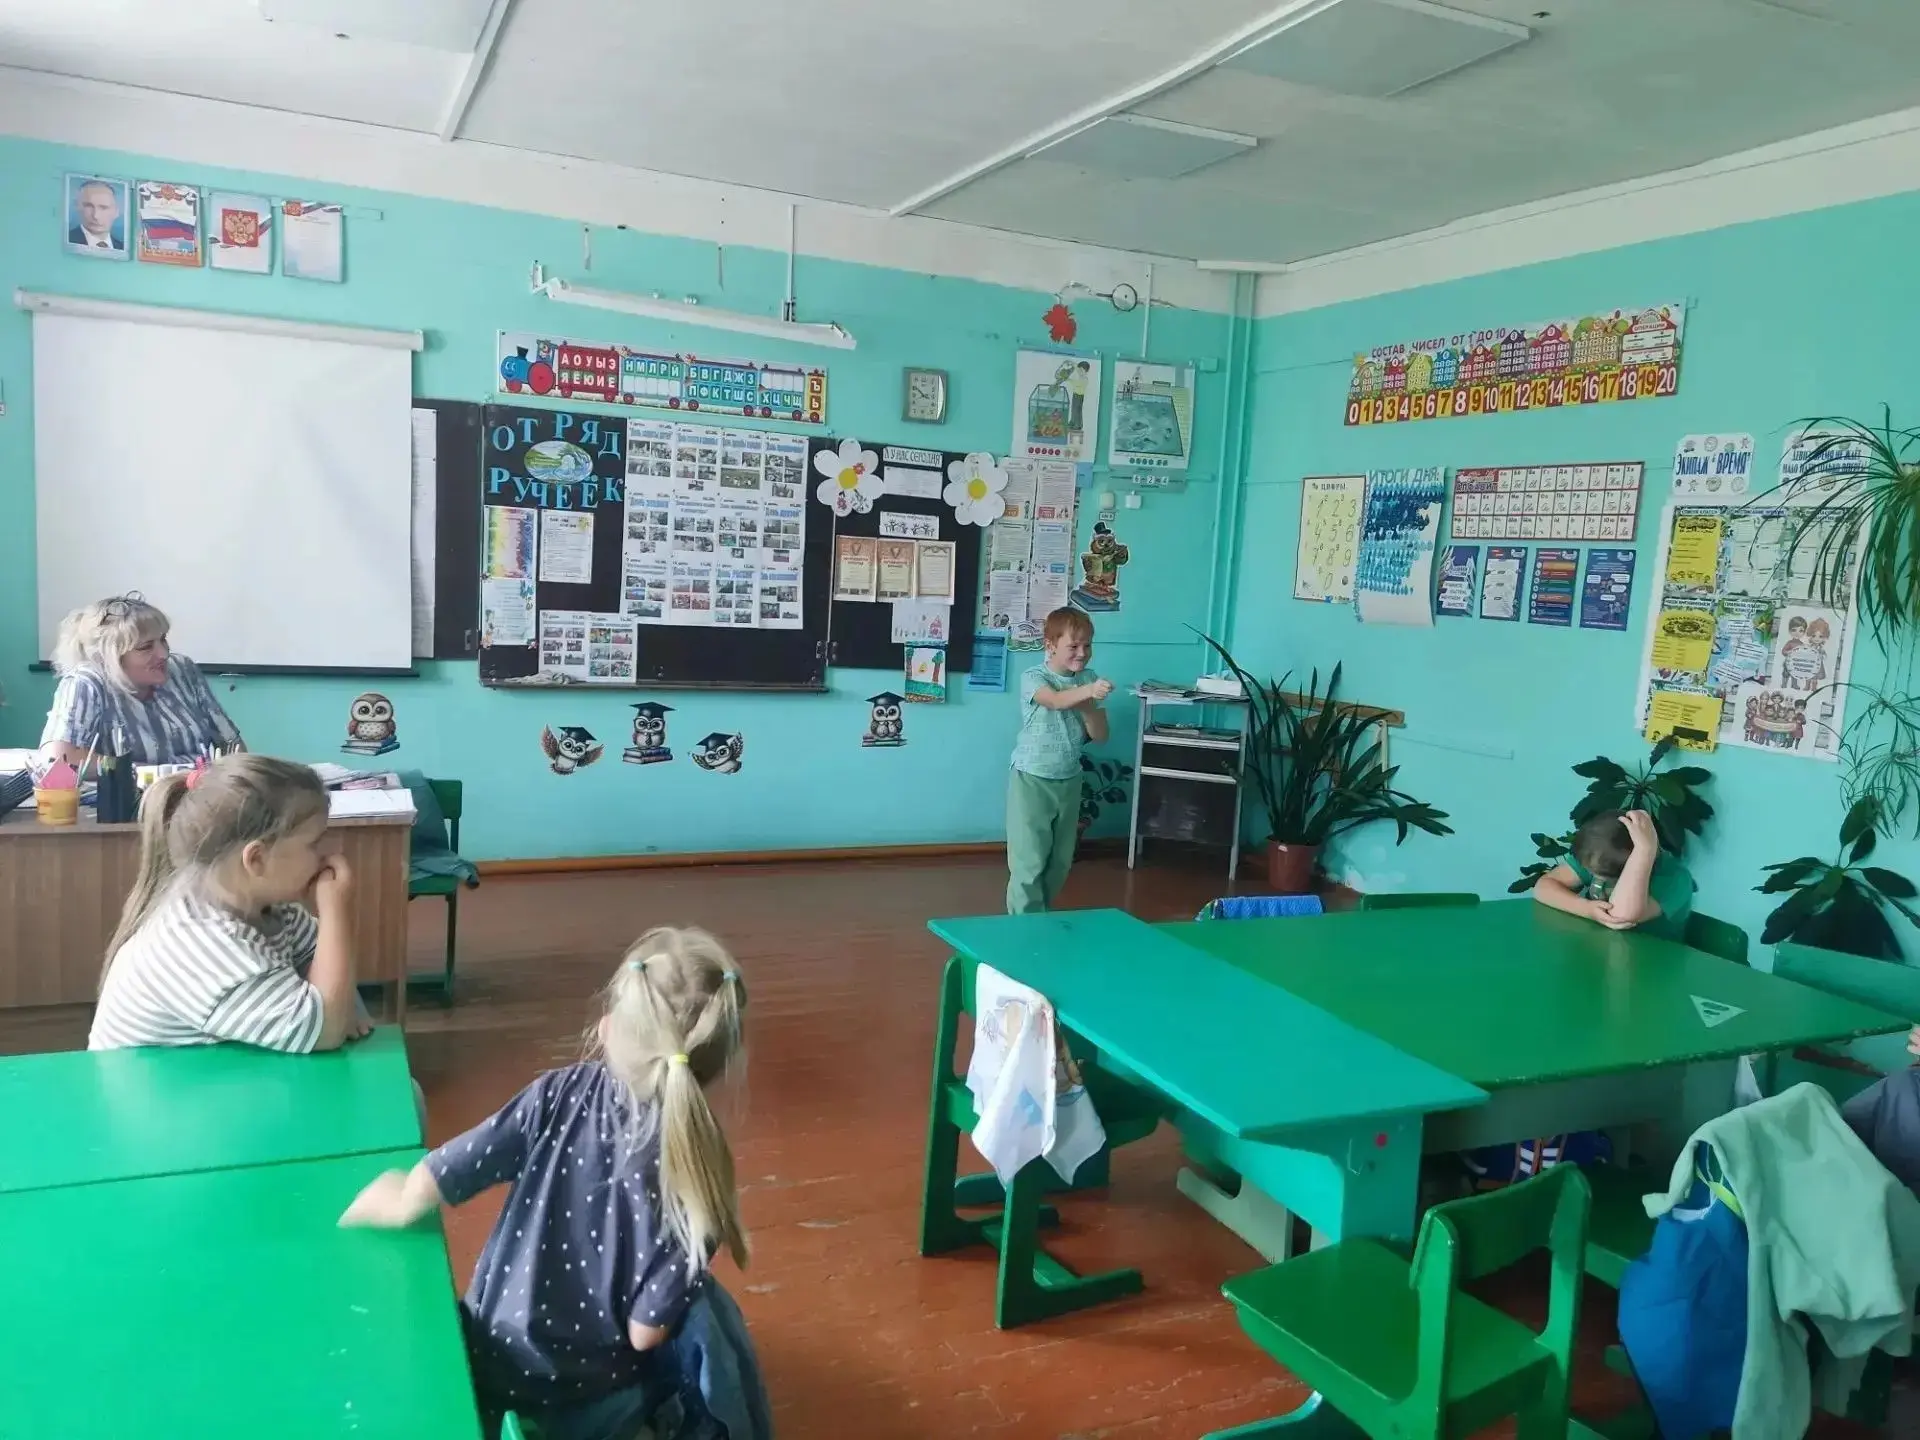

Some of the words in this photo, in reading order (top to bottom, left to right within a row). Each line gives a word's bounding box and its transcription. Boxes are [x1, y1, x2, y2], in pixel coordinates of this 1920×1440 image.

[1371, 344, 1405, 358] СОСТАВ
[1412, 338, 1445, 351] ЧИСЕЛ
[1452, 335, 1465, 346] ОТ
[1477, 330, 1493, 344] ДО
[1496, 328, 1506, 338] 10
[1350, 403, 1359, 423] 0
[1363, 402, 1371, 421] 1
[1374, 401, 1383, 420] 2
[1386, 399, 1396, 419] 3
[1400, 397, 1409, 417] 4
[1413, 396, 1423, 417] 5
[1426, 394, 1435, 415] 6
[1440, 393, 1449, 414] 7
[1455, 391, 1466, 412] 8
[1471, 389, 1482, 411] 9
[1485, 387, 1497, 410] 10
[1501, 387, 1513, 408] 11
[1515, 384, 1530, 406] 12
[1531, 381, 1546, 405] 13
[1548, 379, 1563, 403] 14
[1565, 377, 1581, 401] 15
[1583, 375, 1599, 400] 16
[1601, 373, 1619, 398] 17
[1620, 371, 1637, 396] 18
[1639, 369, 1656, 394] 19
[1657, 367, 1676, 393] 20
[1370, 469, 1409, 484] ИТОГИ
[1676, 454, 1709, 475] ЭКИПАЖ
